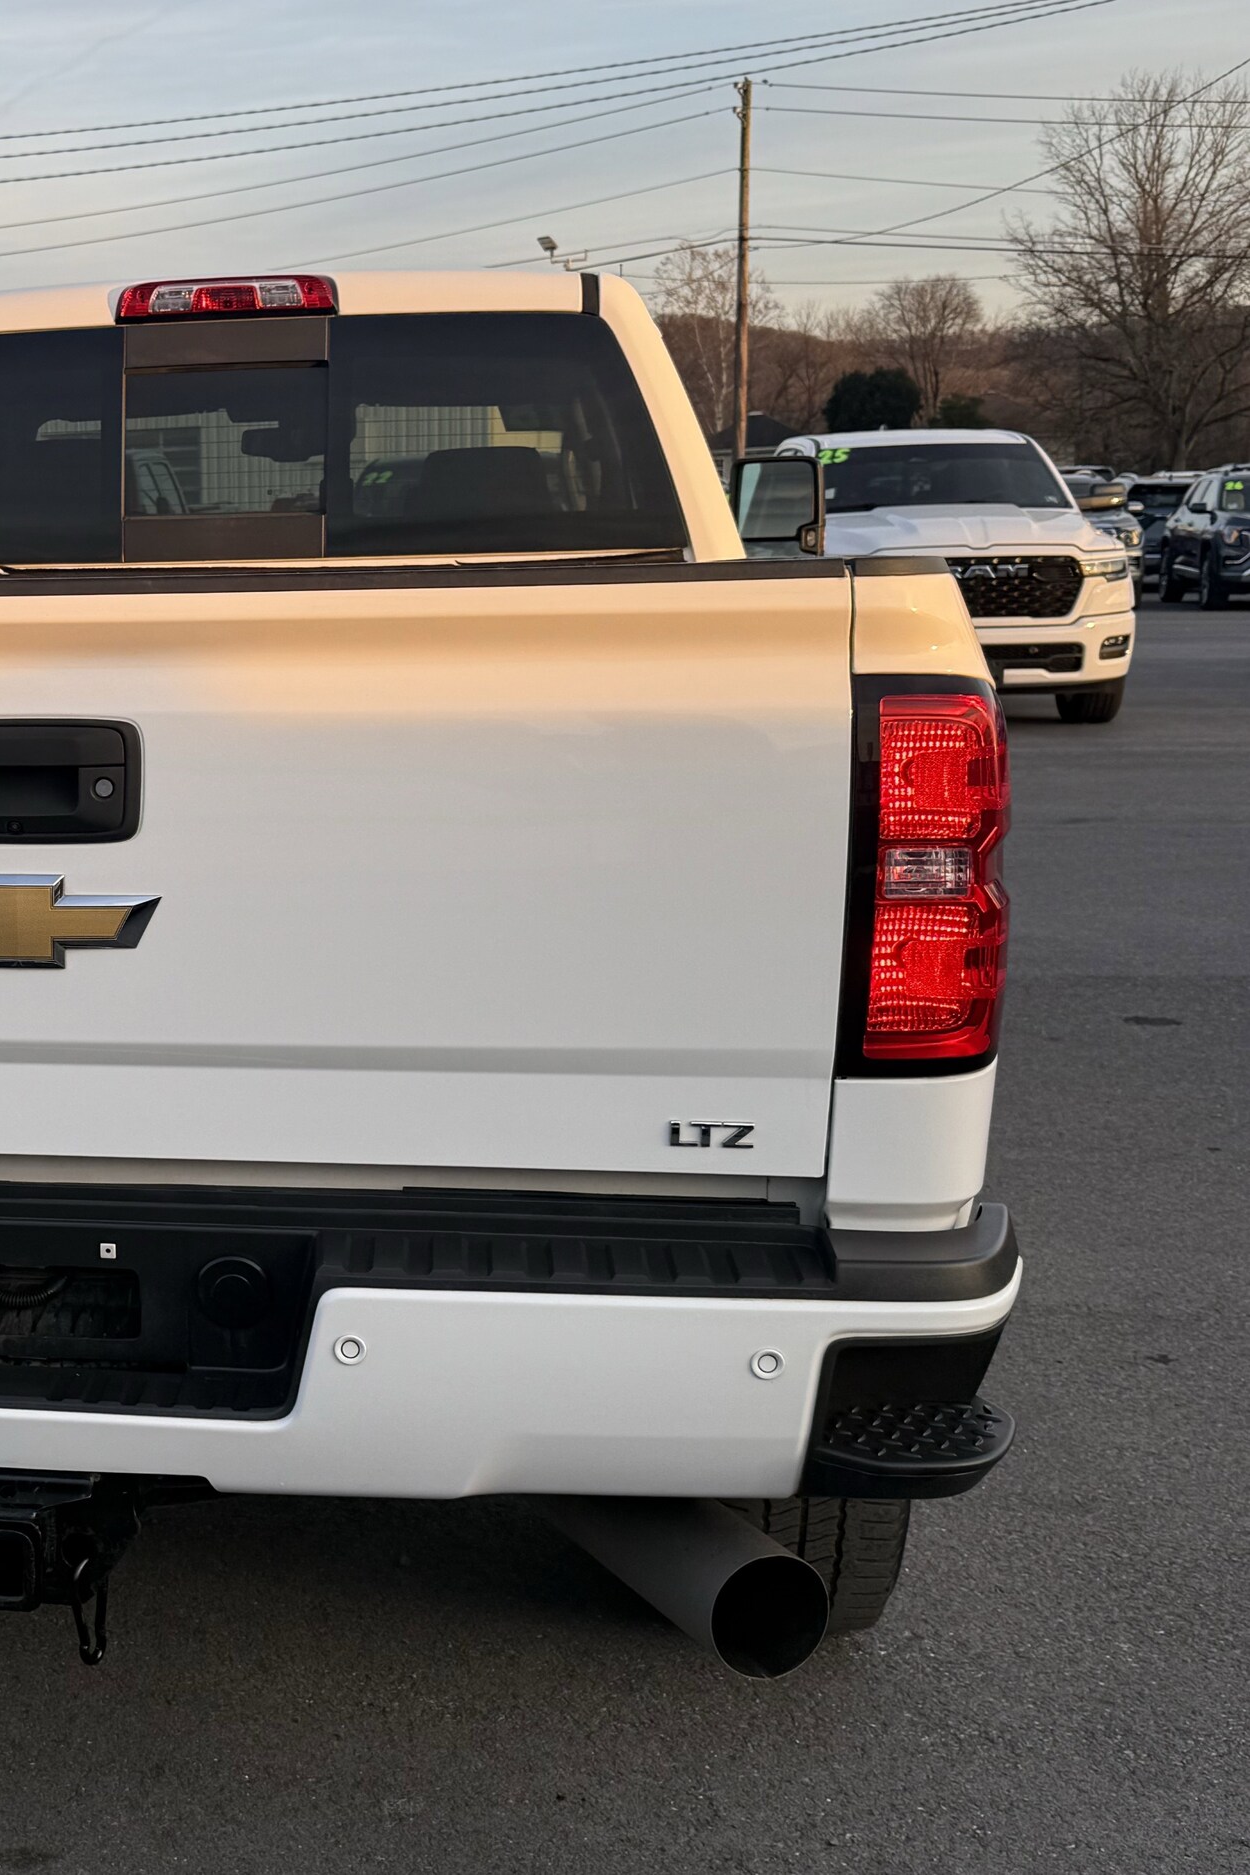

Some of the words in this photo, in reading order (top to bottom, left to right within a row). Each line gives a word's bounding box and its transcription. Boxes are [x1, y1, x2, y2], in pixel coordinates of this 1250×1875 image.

[819, 448, 850, 465] 25
[1224, 481, 1244, 490] 26
[669, 1120, 756, 1148] LTZ
